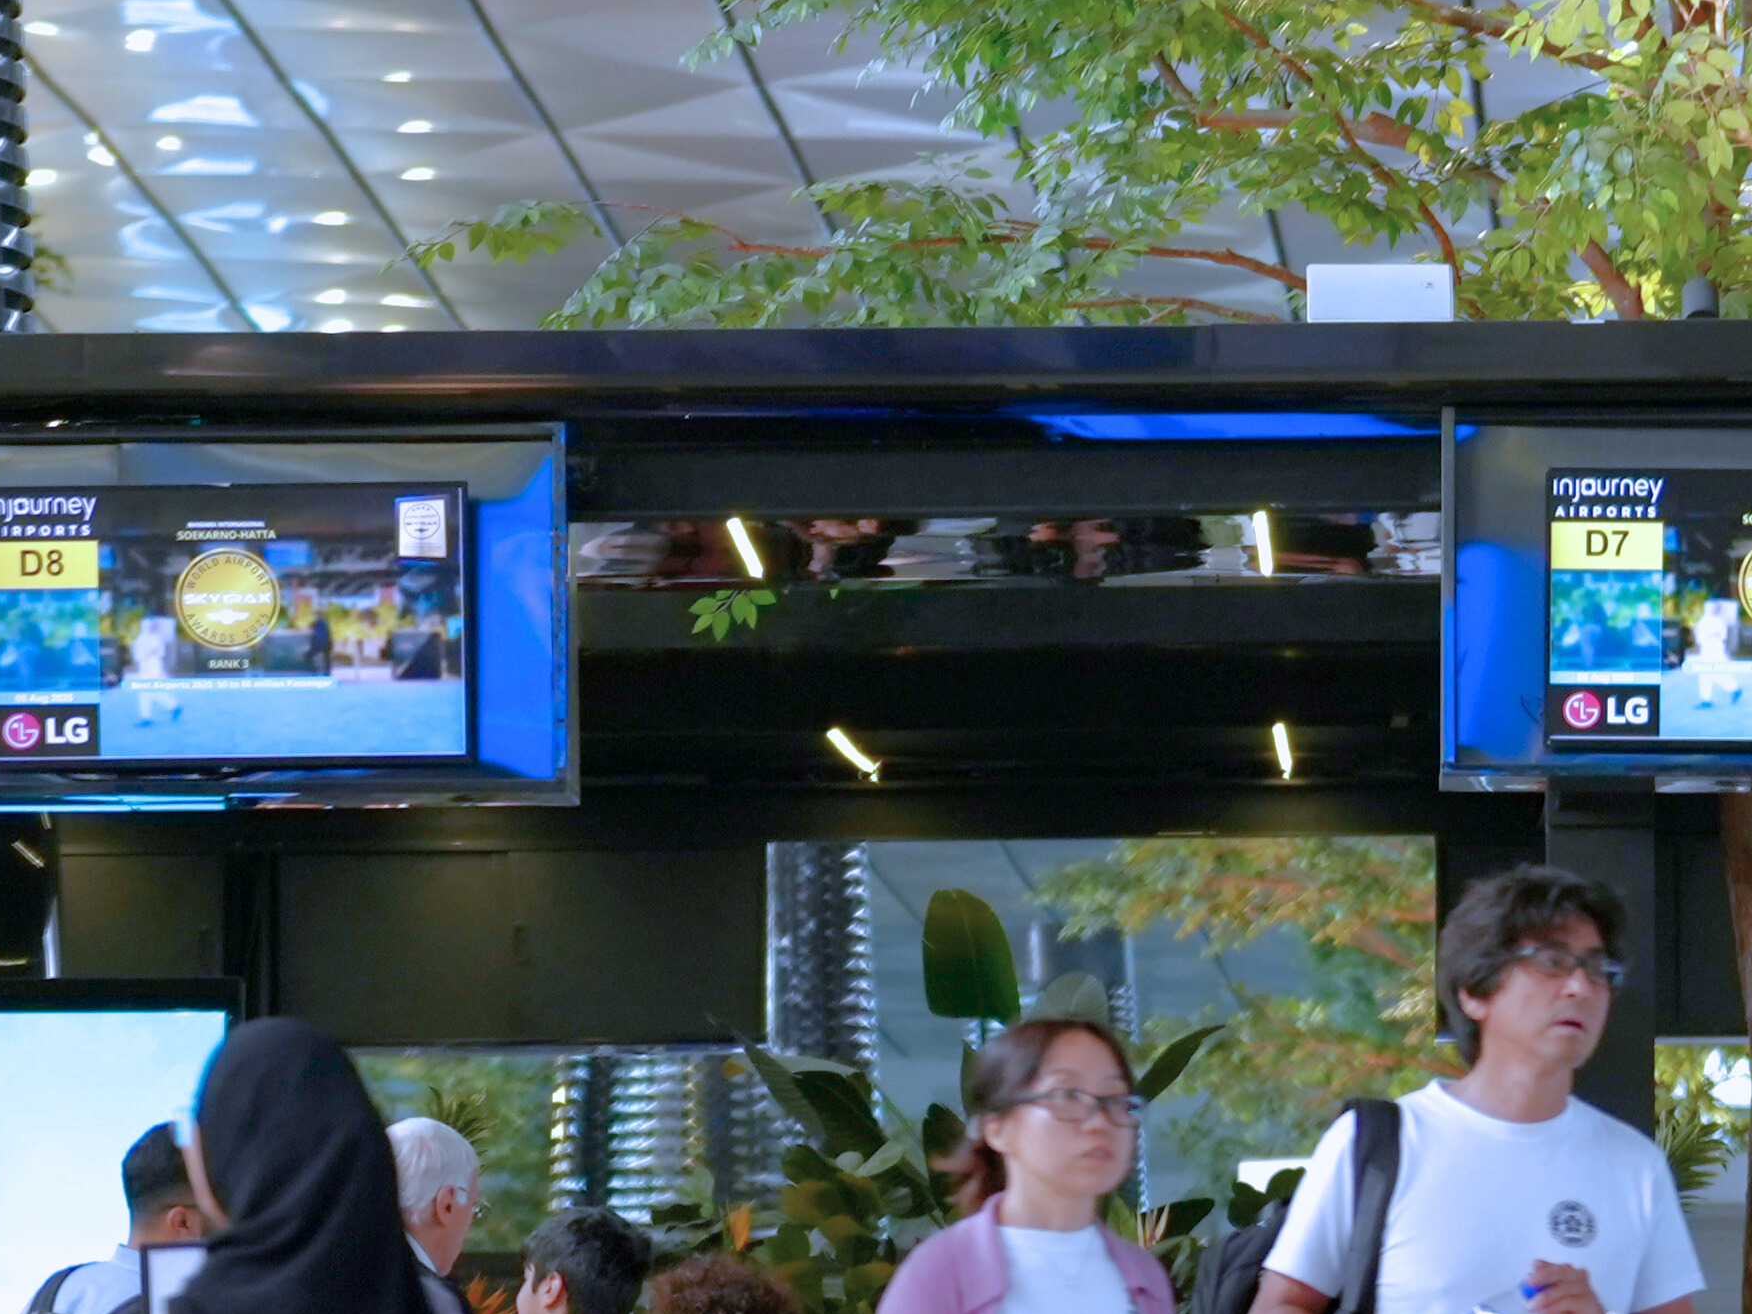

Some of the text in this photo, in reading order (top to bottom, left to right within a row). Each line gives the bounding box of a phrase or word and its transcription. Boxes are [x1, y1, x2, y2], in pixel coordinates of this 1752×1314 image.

[1552, 477, 1664, 503] injourney
[1555, 505, 1656, 518] AIRPORTS
[176, 529, 276, 541] SOEKARNO-HATTA
[1586, 529, 1630, 557] D7
[20, 549, 64, 576] D8
[187, 556, 269, 589] WORLD AIRPORT
[187, 612, 236, 643] AWARDS
[208, 659, 250, 669] RANK 3
[1606, 696, 1648, 724] LG
[45, 715, 89, 744] LG
